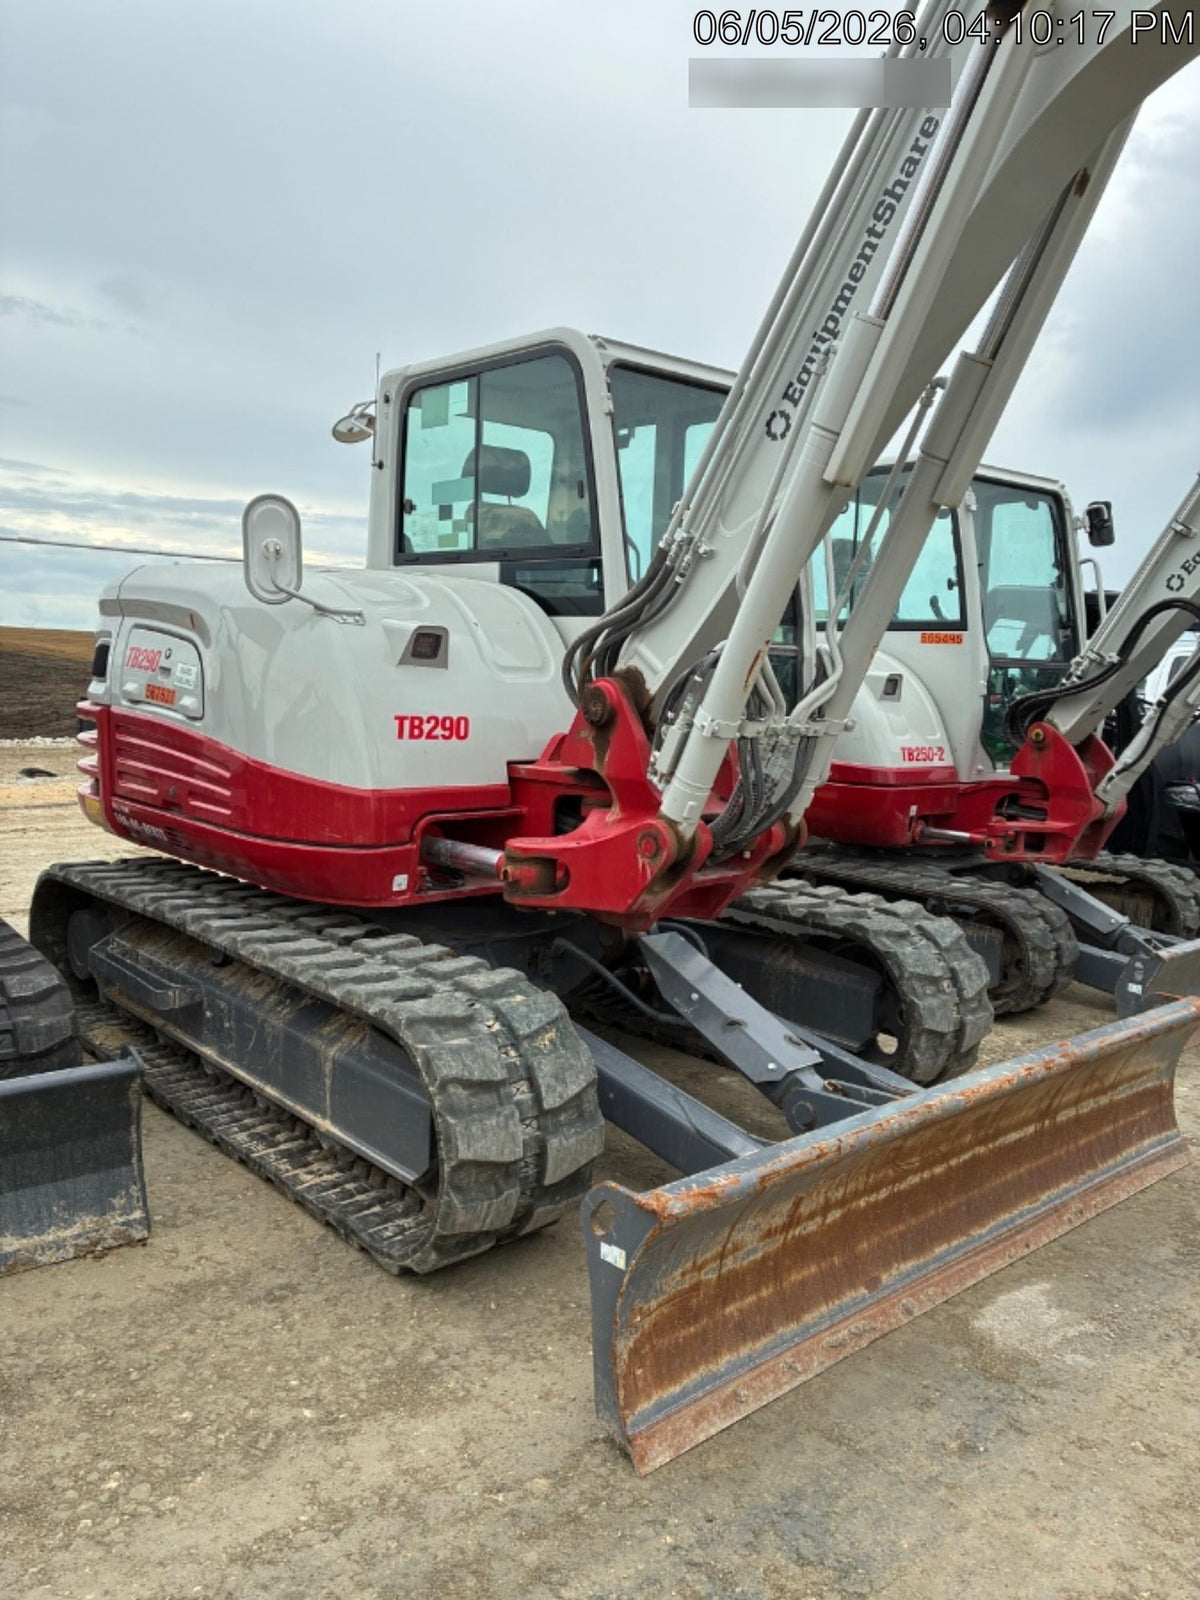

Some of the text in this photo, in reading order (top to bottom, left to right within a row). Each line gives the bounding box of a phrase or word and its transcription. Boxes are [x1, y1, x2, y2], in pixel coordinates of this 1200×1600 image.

[126, 646, 163, 673] TB290
[394, 715, 470, 741] TB290
[900, 746, 945, 762] TB250-2
